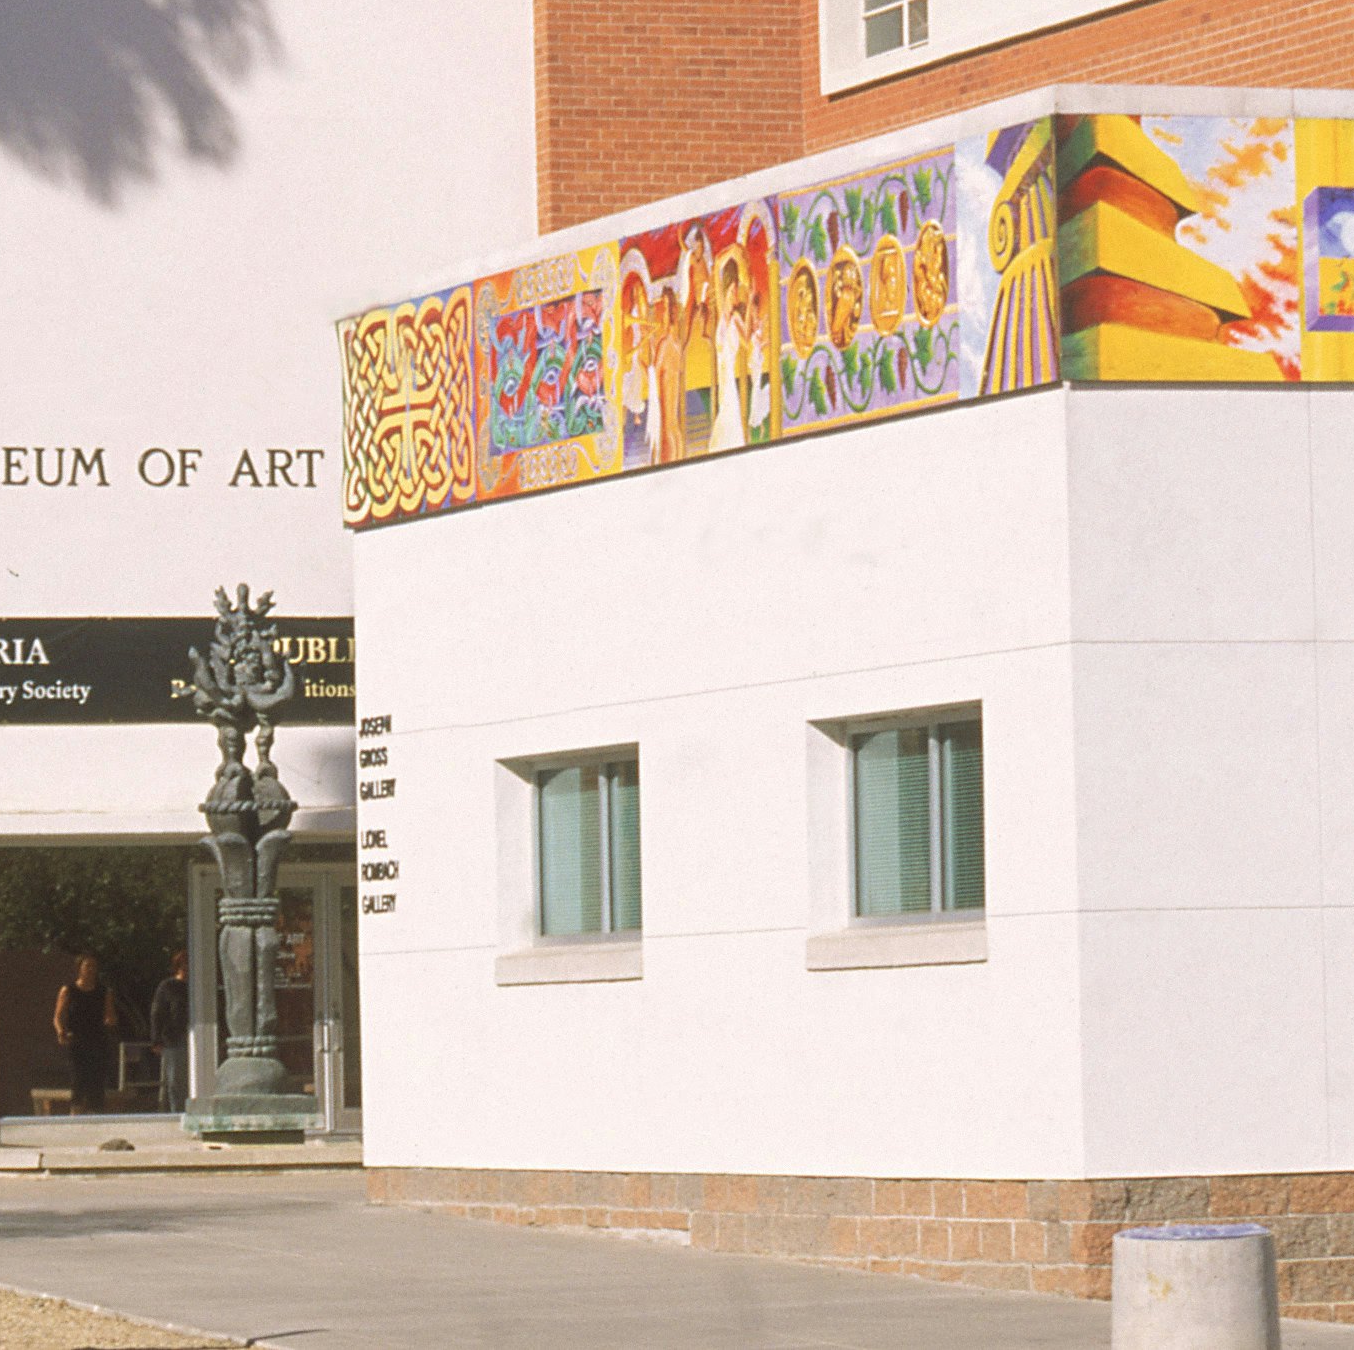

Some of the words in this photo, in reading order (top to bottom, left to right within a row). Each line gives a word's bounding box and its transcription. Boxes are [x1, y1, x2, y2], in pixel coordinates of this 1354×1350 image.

[137, 447, 203, 488] OF
[228, 448, 325, 488] ART
[22, 679, 92, 705] Society
[359, 778, 396, 800] GALLERY
[362, 893, 397, 914] GALLERY
